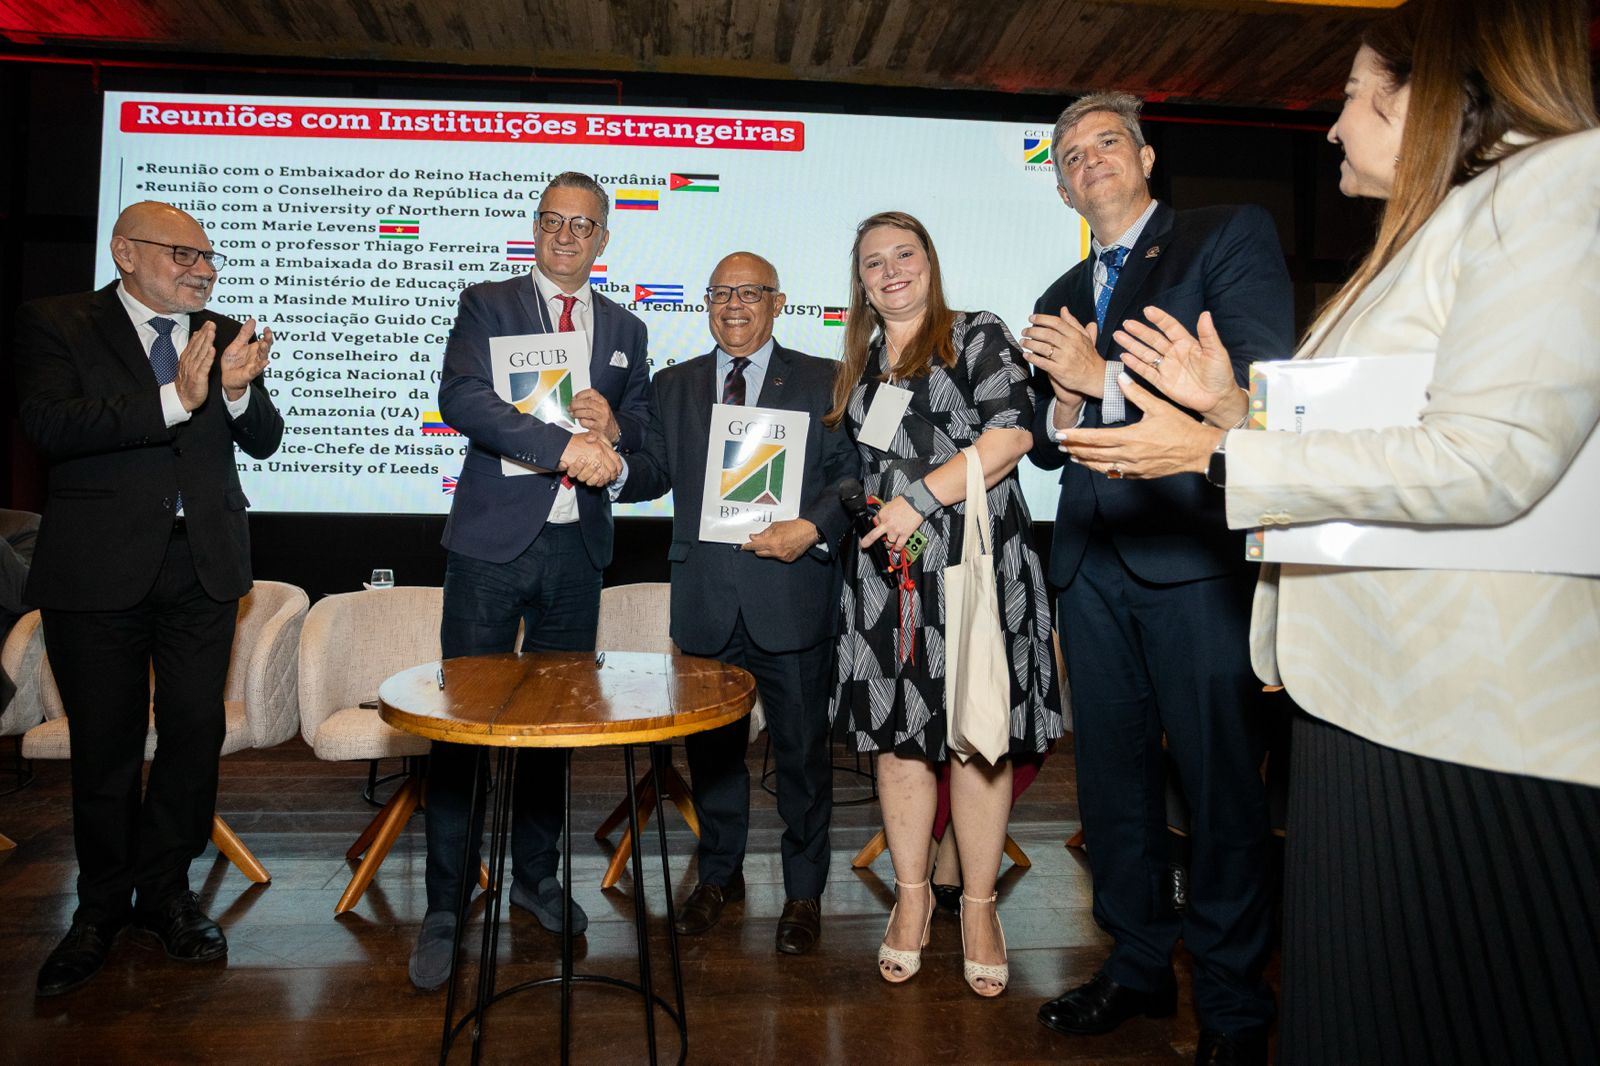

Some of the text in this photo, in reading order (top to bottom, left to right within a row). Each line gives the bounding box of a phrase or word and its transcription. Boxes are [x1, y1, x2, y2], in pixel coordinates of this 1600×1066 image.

[137, 105, 795, 145] Reuniões com Instituições Estrangeiras
[1024, 130, 1053, 138] GCU
[146, 163, 219, 175] Reunião
[223, 167, 259, 176] com
[264, 168, 274, 176] o
[279, 166, 385, 178] Embaixador
[389, 168, 410, 179] do
[415, 169, 464, 180] Reino
[469, 171, 557, 182] Hachemit
[145, 181, 218, 193] Reunião
[222, 185, 259, 194] com
[263, 186, 273, 194] o
[278, 184, 383, 197] Conselheiro
[387, 186, 408, 197] da
[413, 187, 498, 201] República
[503, 189, 523, 200] da
[221, 204, 258, 212] com
[262, 204, 272, 212] a
[278, 202, 371, 218] University
[376, 204, 396, 215] of
[399, 205, 480, 217] Northern
[485, 207, 526, 218] Iowa
[220, 222, 257, 230] com
[262, 220, 312, 231] Marie
[317, 222, 376, 233] Levens
[220, 240, 256, 249] com
[261, 241, 271, 249] o
[276, 239, 360, 252] professor
[364, 240, 424, 255] Thiago
[429, 242, 499, 253] Ferreira
[224, 258, 255, 267] com
[260, 259, 270, 267] a
[276, 257, 372, 269] Embaixada
[377, 259, 398, 270] do
[403, 259, 454, 271] Brasil
[458, 263, 485, 271] em
[218, 277, 254, 285] com
[259, 278, 269, 286] o
[274, 275, 366, 287] Ministério
[370, 277, 391, 288] de
[217, 295, 254, 304] com
[259, 296, 268, 304] a
[274, 294, 347, 305] Masinde
[352, 295, 410, 307] Muliro
[258, 314, 268, 322] a
[272, 312, 369, 327] Associação
[374, 314, 426, 325] Guido
[272, 331, 326, 343] World
[331, 332, 419, 346] Vegetable
[271, 352, 281, 360] o
[293, 350, 398, 362] Conselheiro
[410, 351, 430, 362] da
[509, 349, 568, 368] GCUB
[263, 367, 341, 383] dagógica
[347, 369, 425, 381] Nacional
[269, 387, 429, 400] o Conselheiro da
[286, 406, 376, 417] Amazonia
[380, 406, 420, 421] (UA)
[284, 425, 389, 436] resentantes
[394, 425, 415, 437] da
[281, 442, 365, 455] ice-Chefe
[369, 443, 390, 455] de
[395, 444, 454, 456] Missão
[252, 463, 263, 472] a
[268, 461, 363, 476] University
[367, 462, 386, 474] of
[390, 463, 439, 475] Leeds
